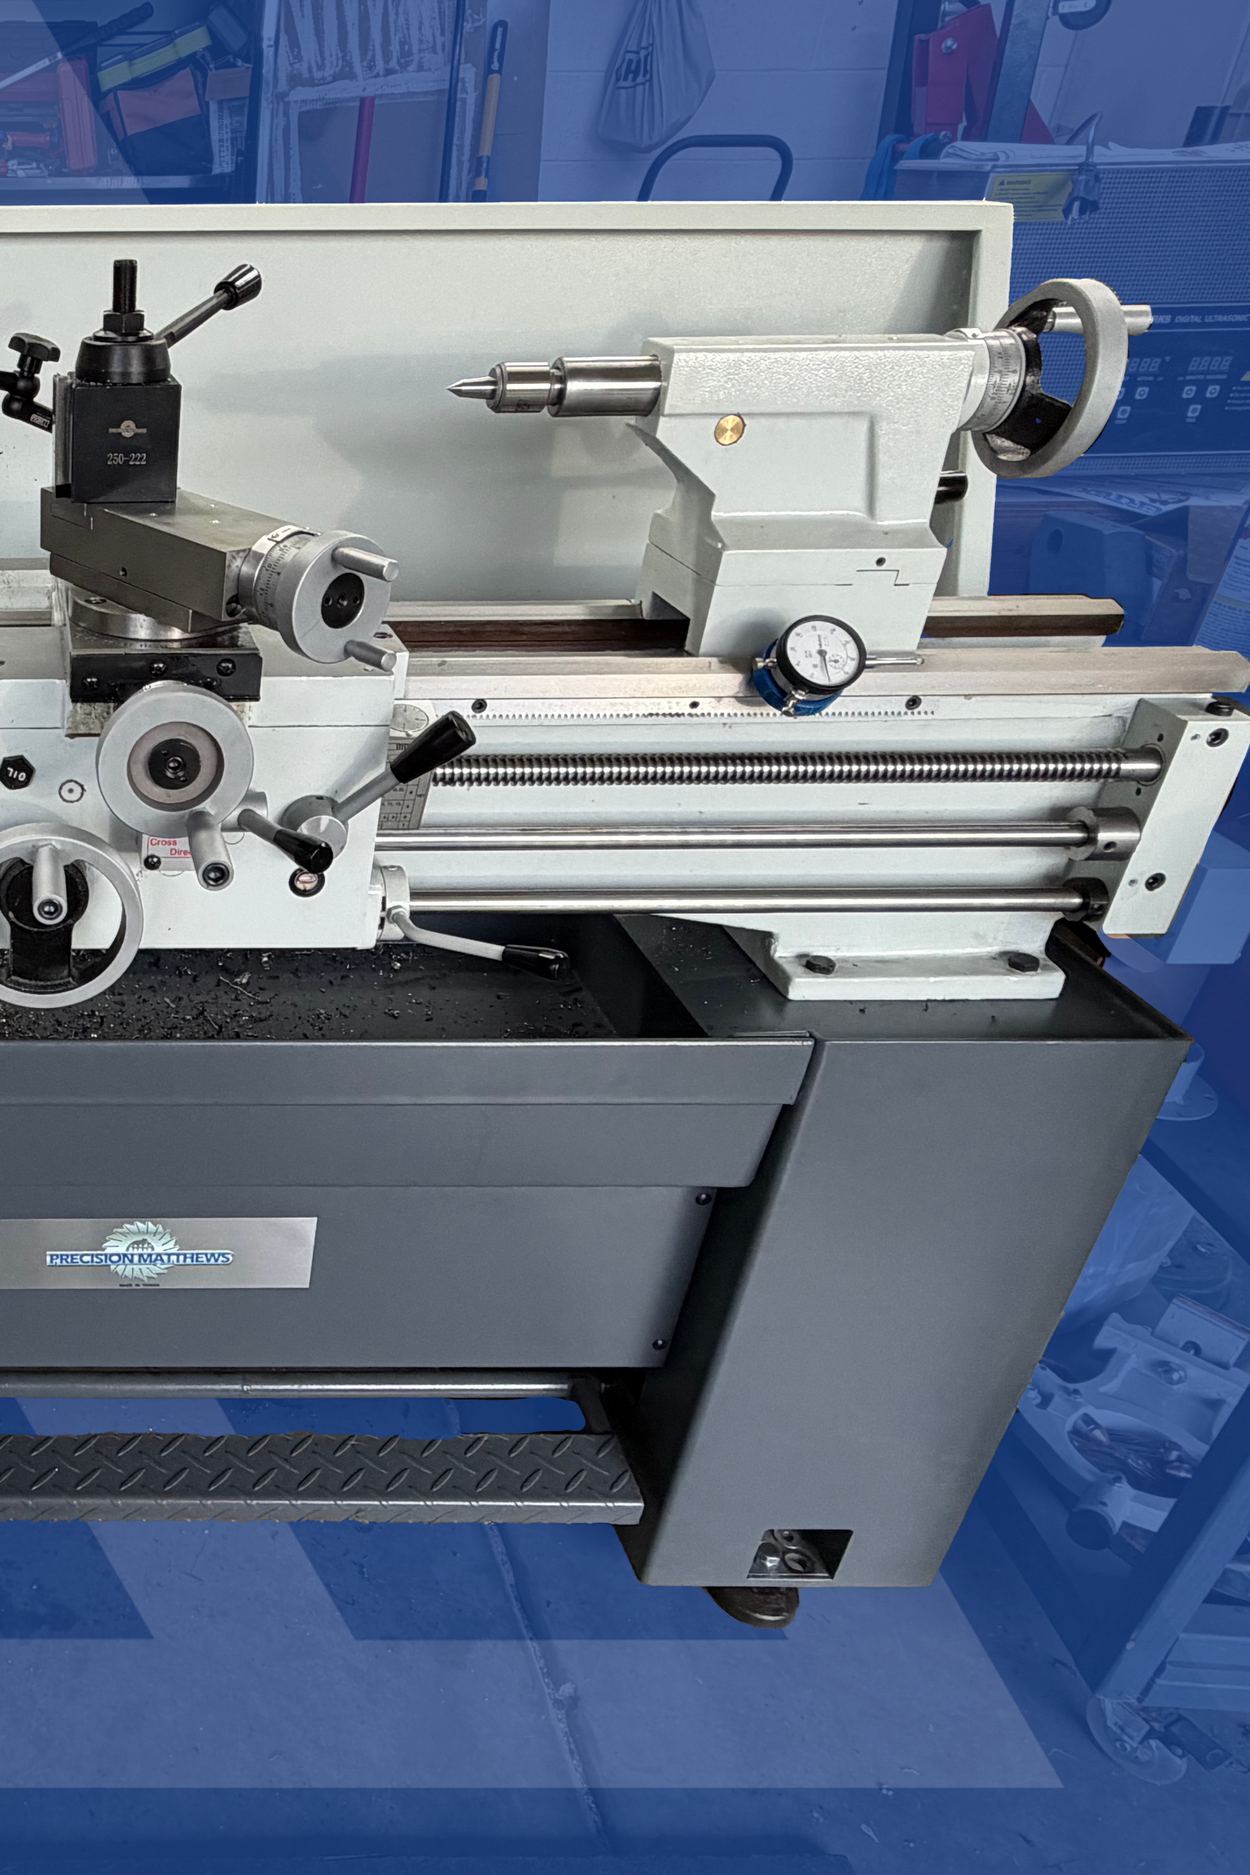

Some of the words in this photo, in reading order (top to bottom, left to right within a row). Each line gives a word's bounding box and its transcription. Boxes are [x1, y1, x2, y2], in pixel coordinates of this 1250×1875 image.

[1174, 315, 1202, 323] DIGITAL
[107, 453, 146, 465] 250-222
[150, 838, 177, 846] Cross
[49, 1252, 134, 1266] PRECISION
[138, 1251, 231, 1265] MATTHEWS
